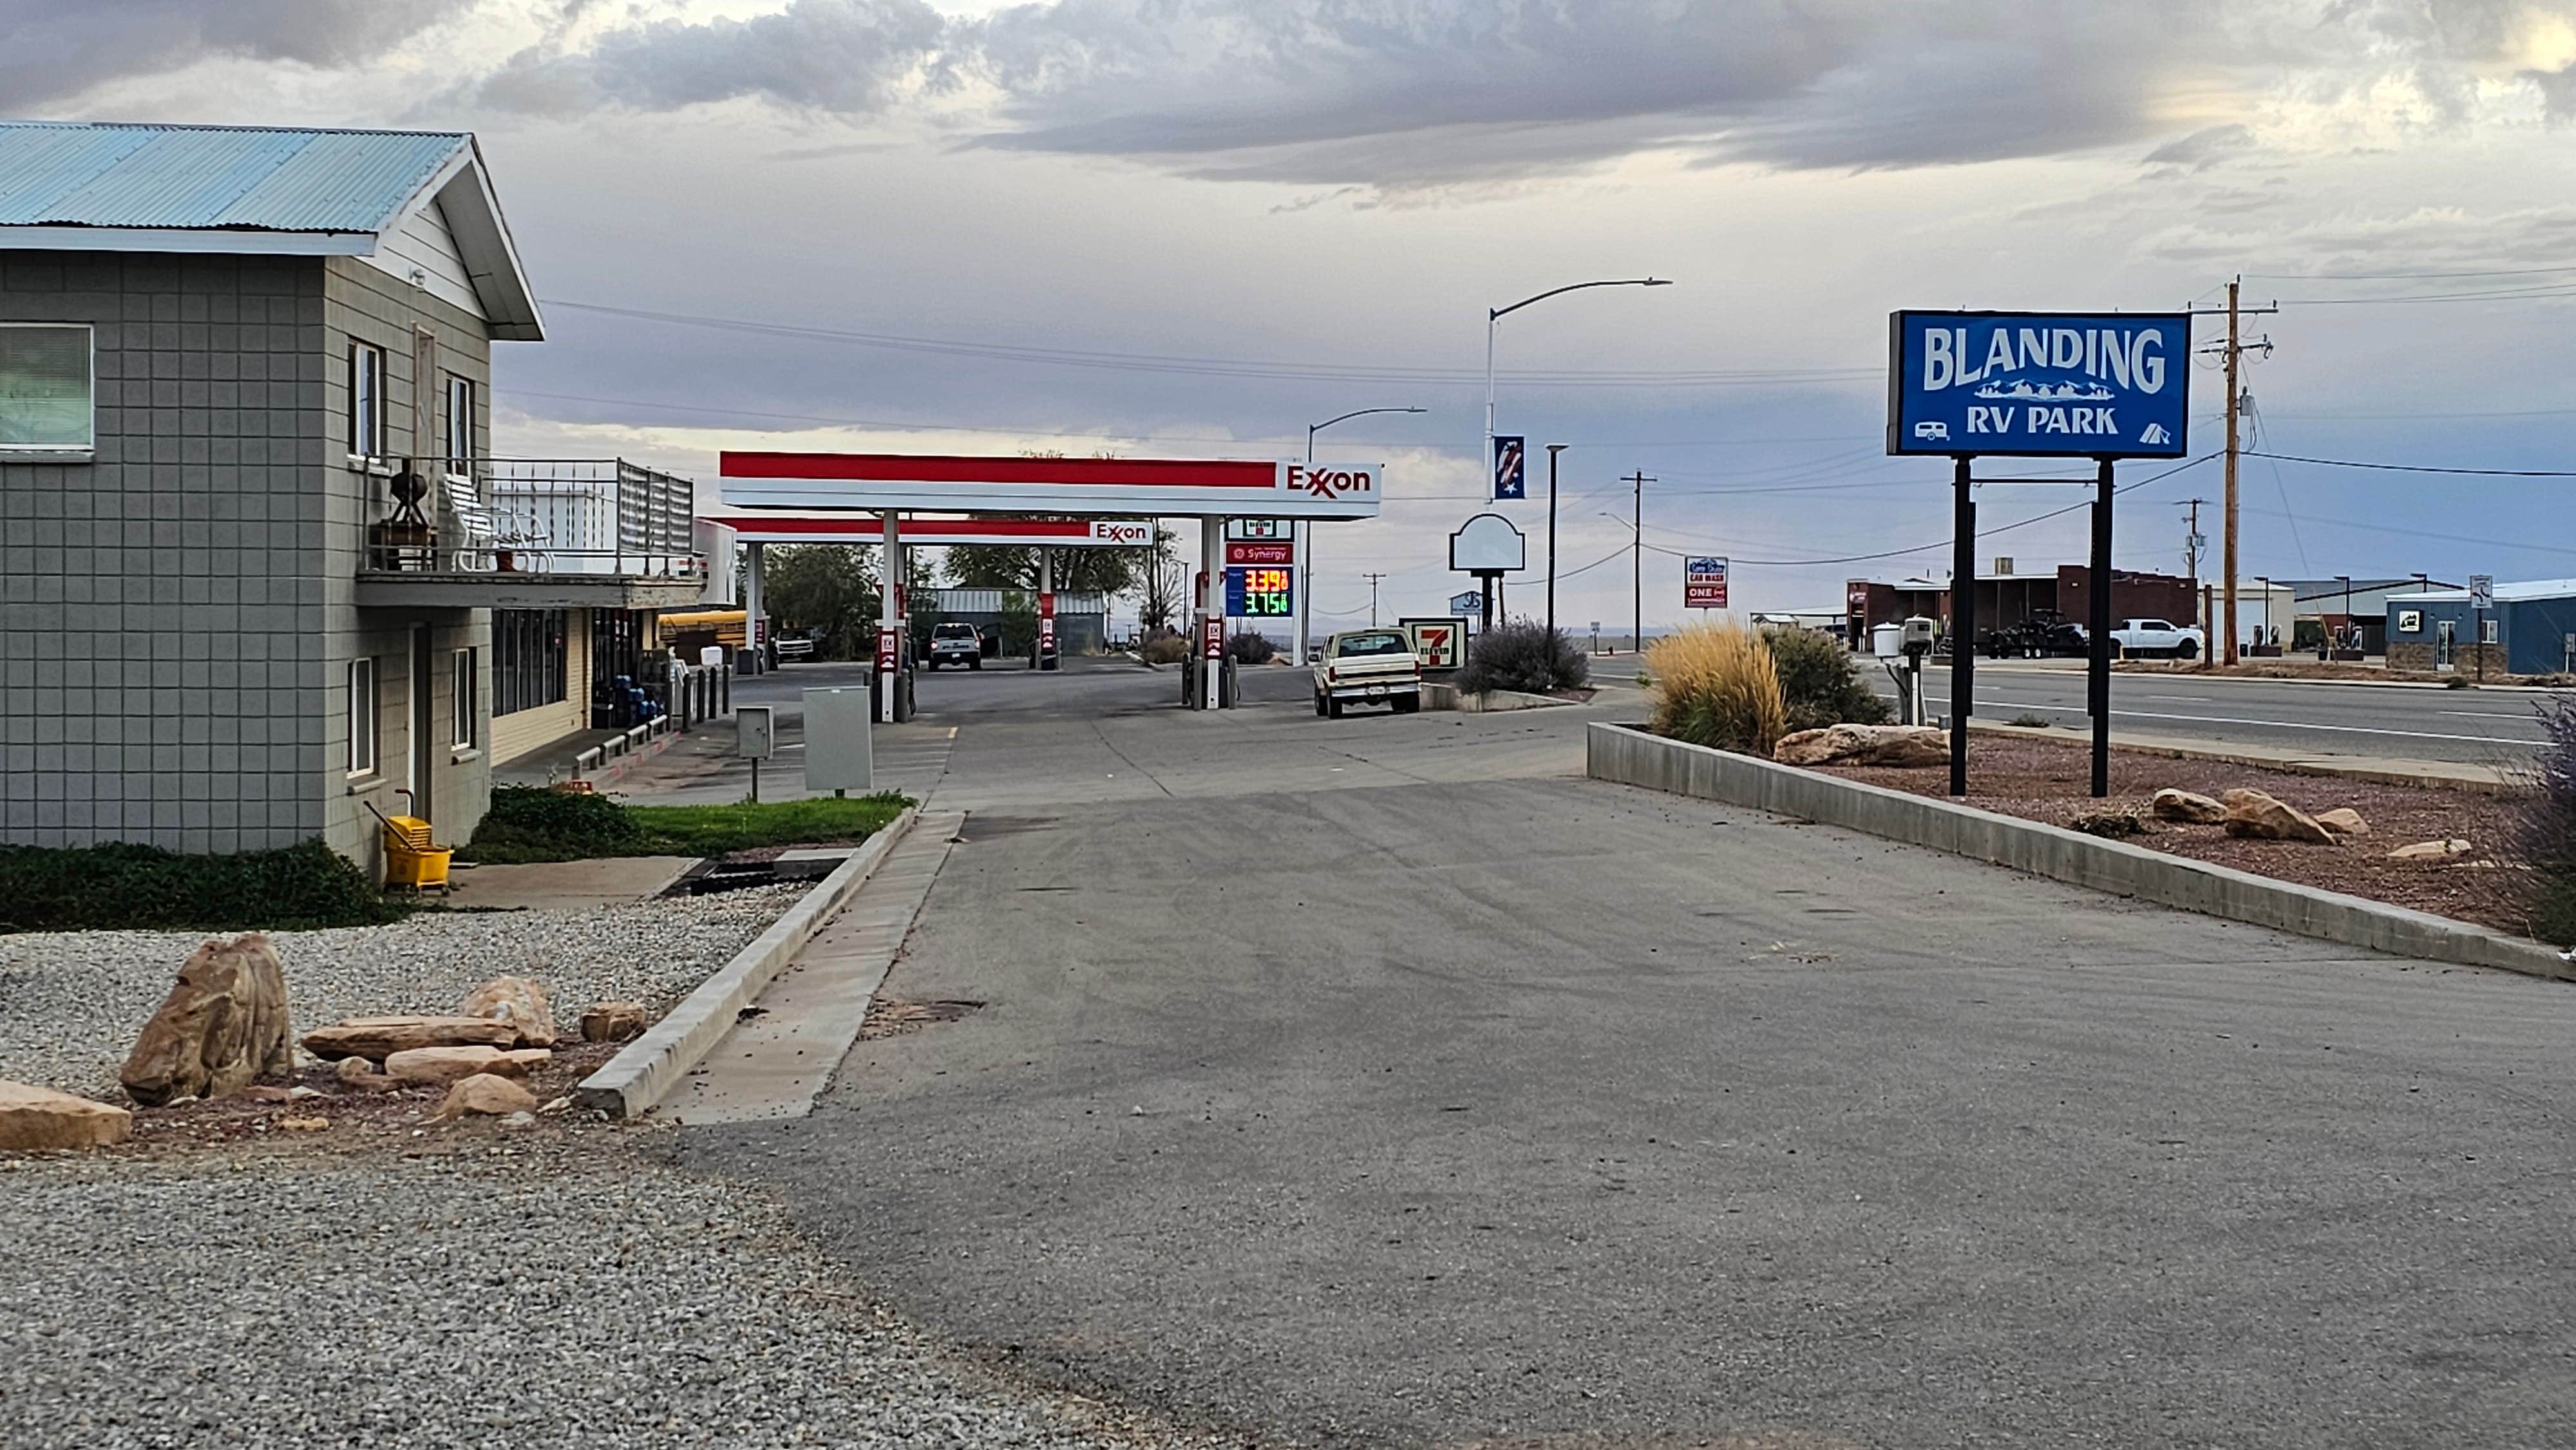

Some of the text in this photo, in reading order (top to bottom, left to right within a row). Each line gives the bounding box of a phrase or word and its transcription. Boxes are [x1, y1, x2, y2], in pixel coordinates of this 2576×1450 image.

[1924, 328, 2165, 394] BLANDING
[1967, 406, 2119, 435] RV PARK
[1287, 466, 1370, 499] Exxon
[1097, 523, 1146, 543] Exxon
[1247, 549, 1286, 561] Synergy
[1689, 588, 1712, 597] ONE
[1421, 628, 1448, 666] 7
